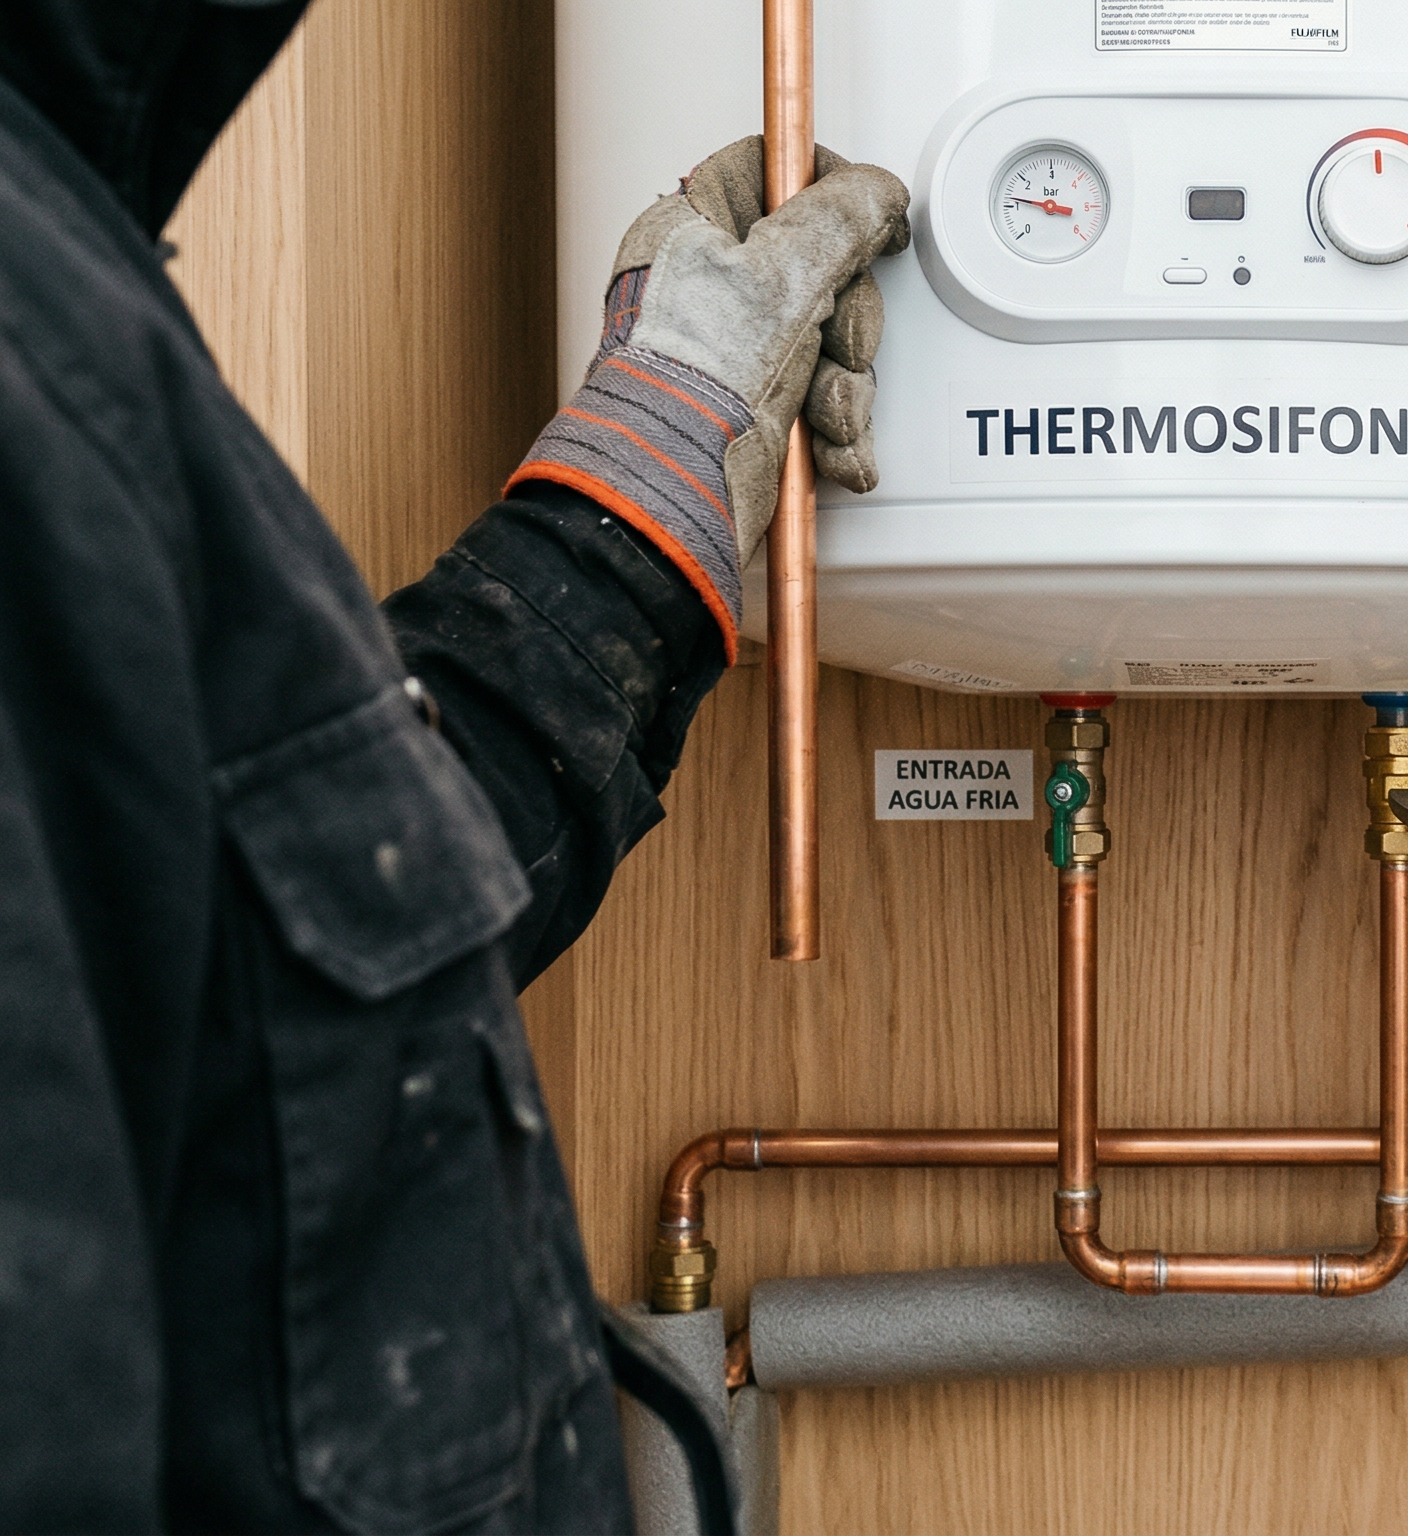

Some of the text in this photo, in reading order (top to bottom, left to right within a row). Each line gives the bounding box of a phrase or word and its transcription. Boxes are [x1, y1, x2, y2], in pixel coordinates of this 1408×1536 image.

[1024, 181, 1031, 191] 2
[1071, 180, 1077, 190] 4
[1043, 186, 1059, 197] bar
[1084, 202, 1090, 212] 5
[1025, 223, 1031, 234] 0
[1073, 224, 1080, 235] 6
[896, 759, 1011, 780] ENTRADA
[888, 789, 1020, 810] AGUA FRIA
